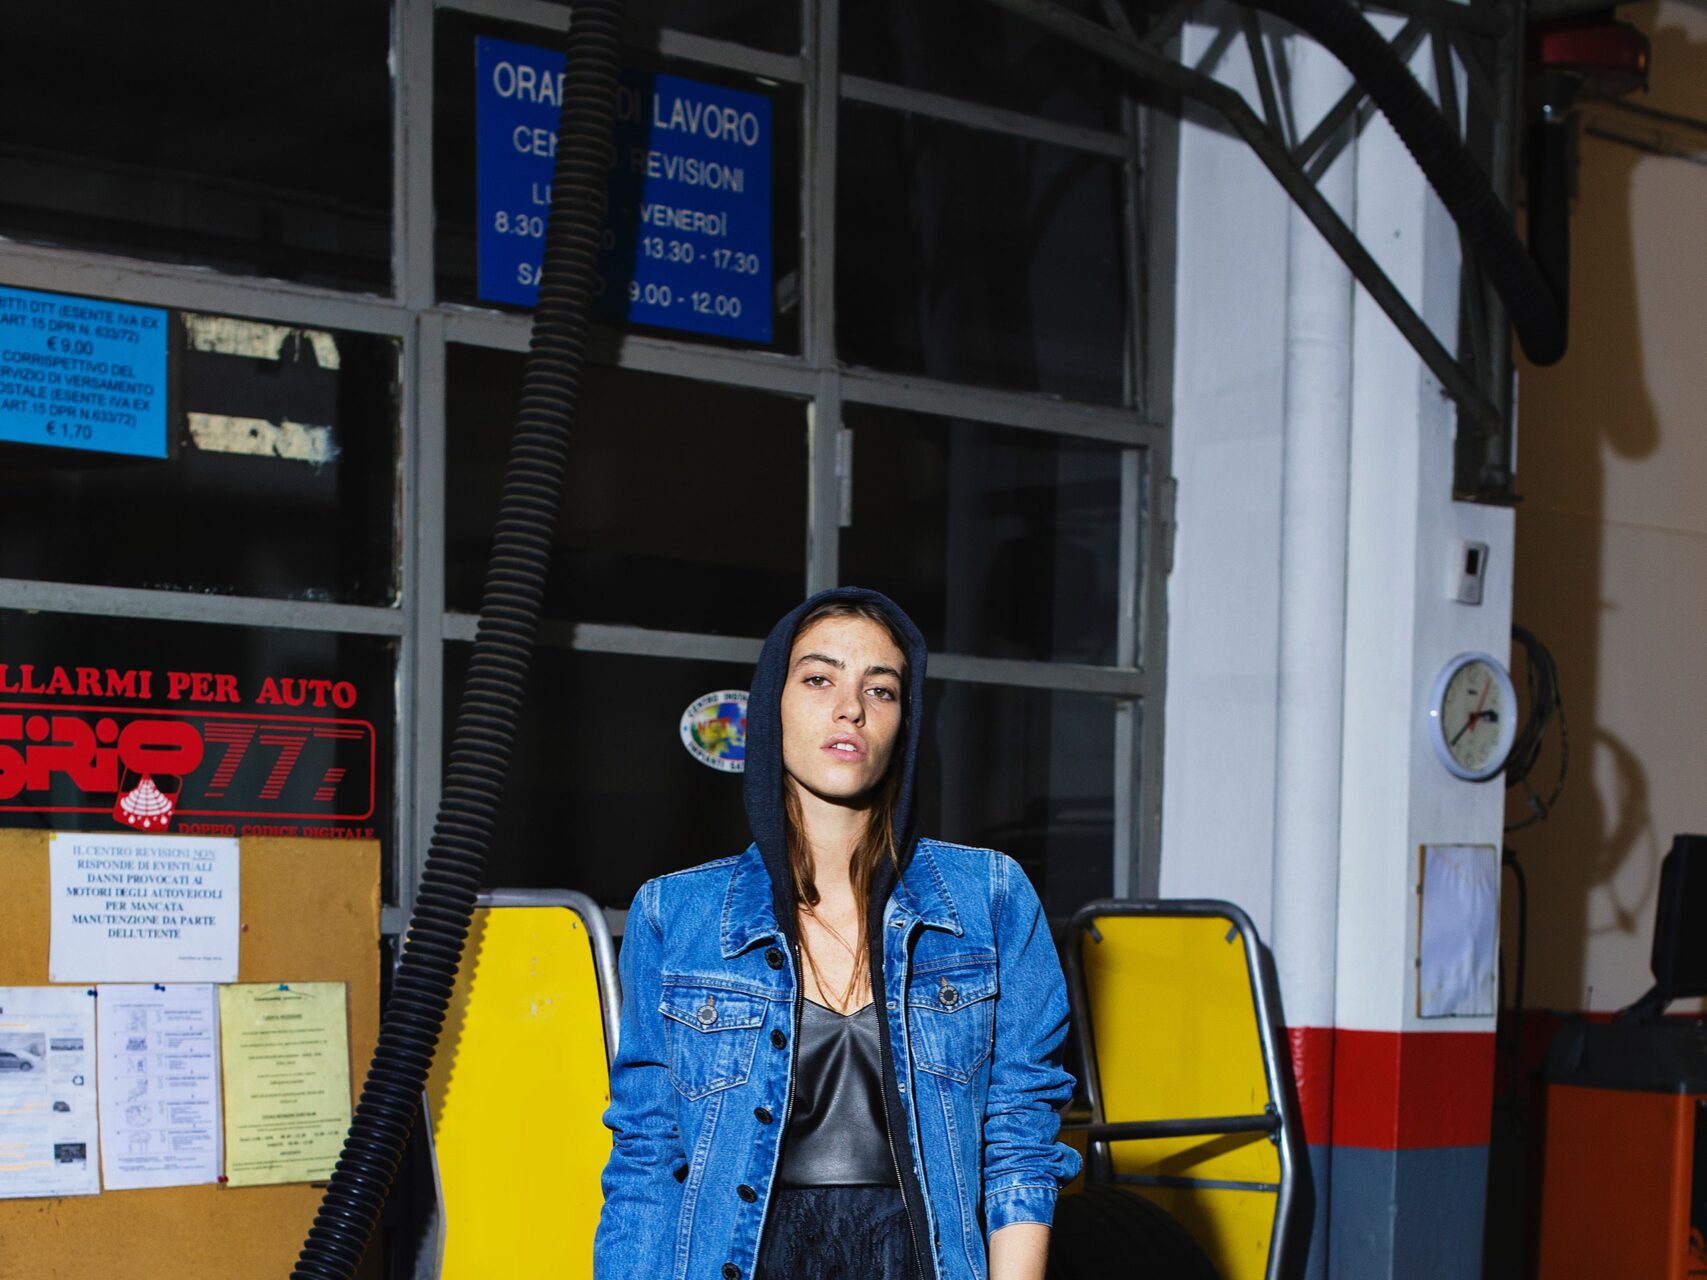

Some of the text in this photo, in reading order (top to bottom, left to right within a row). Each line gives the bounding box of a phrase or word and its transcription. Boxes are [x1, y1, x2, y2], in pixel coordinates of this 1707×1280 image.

[493, 61, 567, 106] ORA
[653, 94, 760, 147] LAVORO
[630, 148, 745, 193] REVISIONI
[639, 203, 728, 237] VENERDÌ
[494, 211, 544, 239] 8.30
[643, 236, 695, 263] 13.30
[712, 248, 760, 276] 17.30
[628, 280, 672, 308] 9.00
[690, 291, 742, 319] 12.00
[118, 312, 137, 326] IVA
[141, 316, 159, 329] EX
[2, 350, 135, 378] CORRISPETTIVO DEL
[48, 371, 61, 383] DI
[65, 375, 154, 396] VERSAMENTO
[49, 404, 76, 417] DPR
[109, 395, 129, 409] IVA
[133, 398, 150, 411] EX
[0, 664, 357, 709] LLARMI PER AUTO
[73, 846, 215, 858] IL CENTRO REVISIONI NON
[77, 859, 213, 872] RISPONDE DI EVENTUALI
[87, 874, 203, 885] DANNI PROVOCATI AI
[67, 887, 223, 899] MOTORI DEGLI AUTOVEICOLI
[105, 901, 183, 912] PER MANCATA
[72, 914, 216, 926] MANUTENZIONE DA PARTE
[108, 928, 181, 939] DELL'UTENTE
